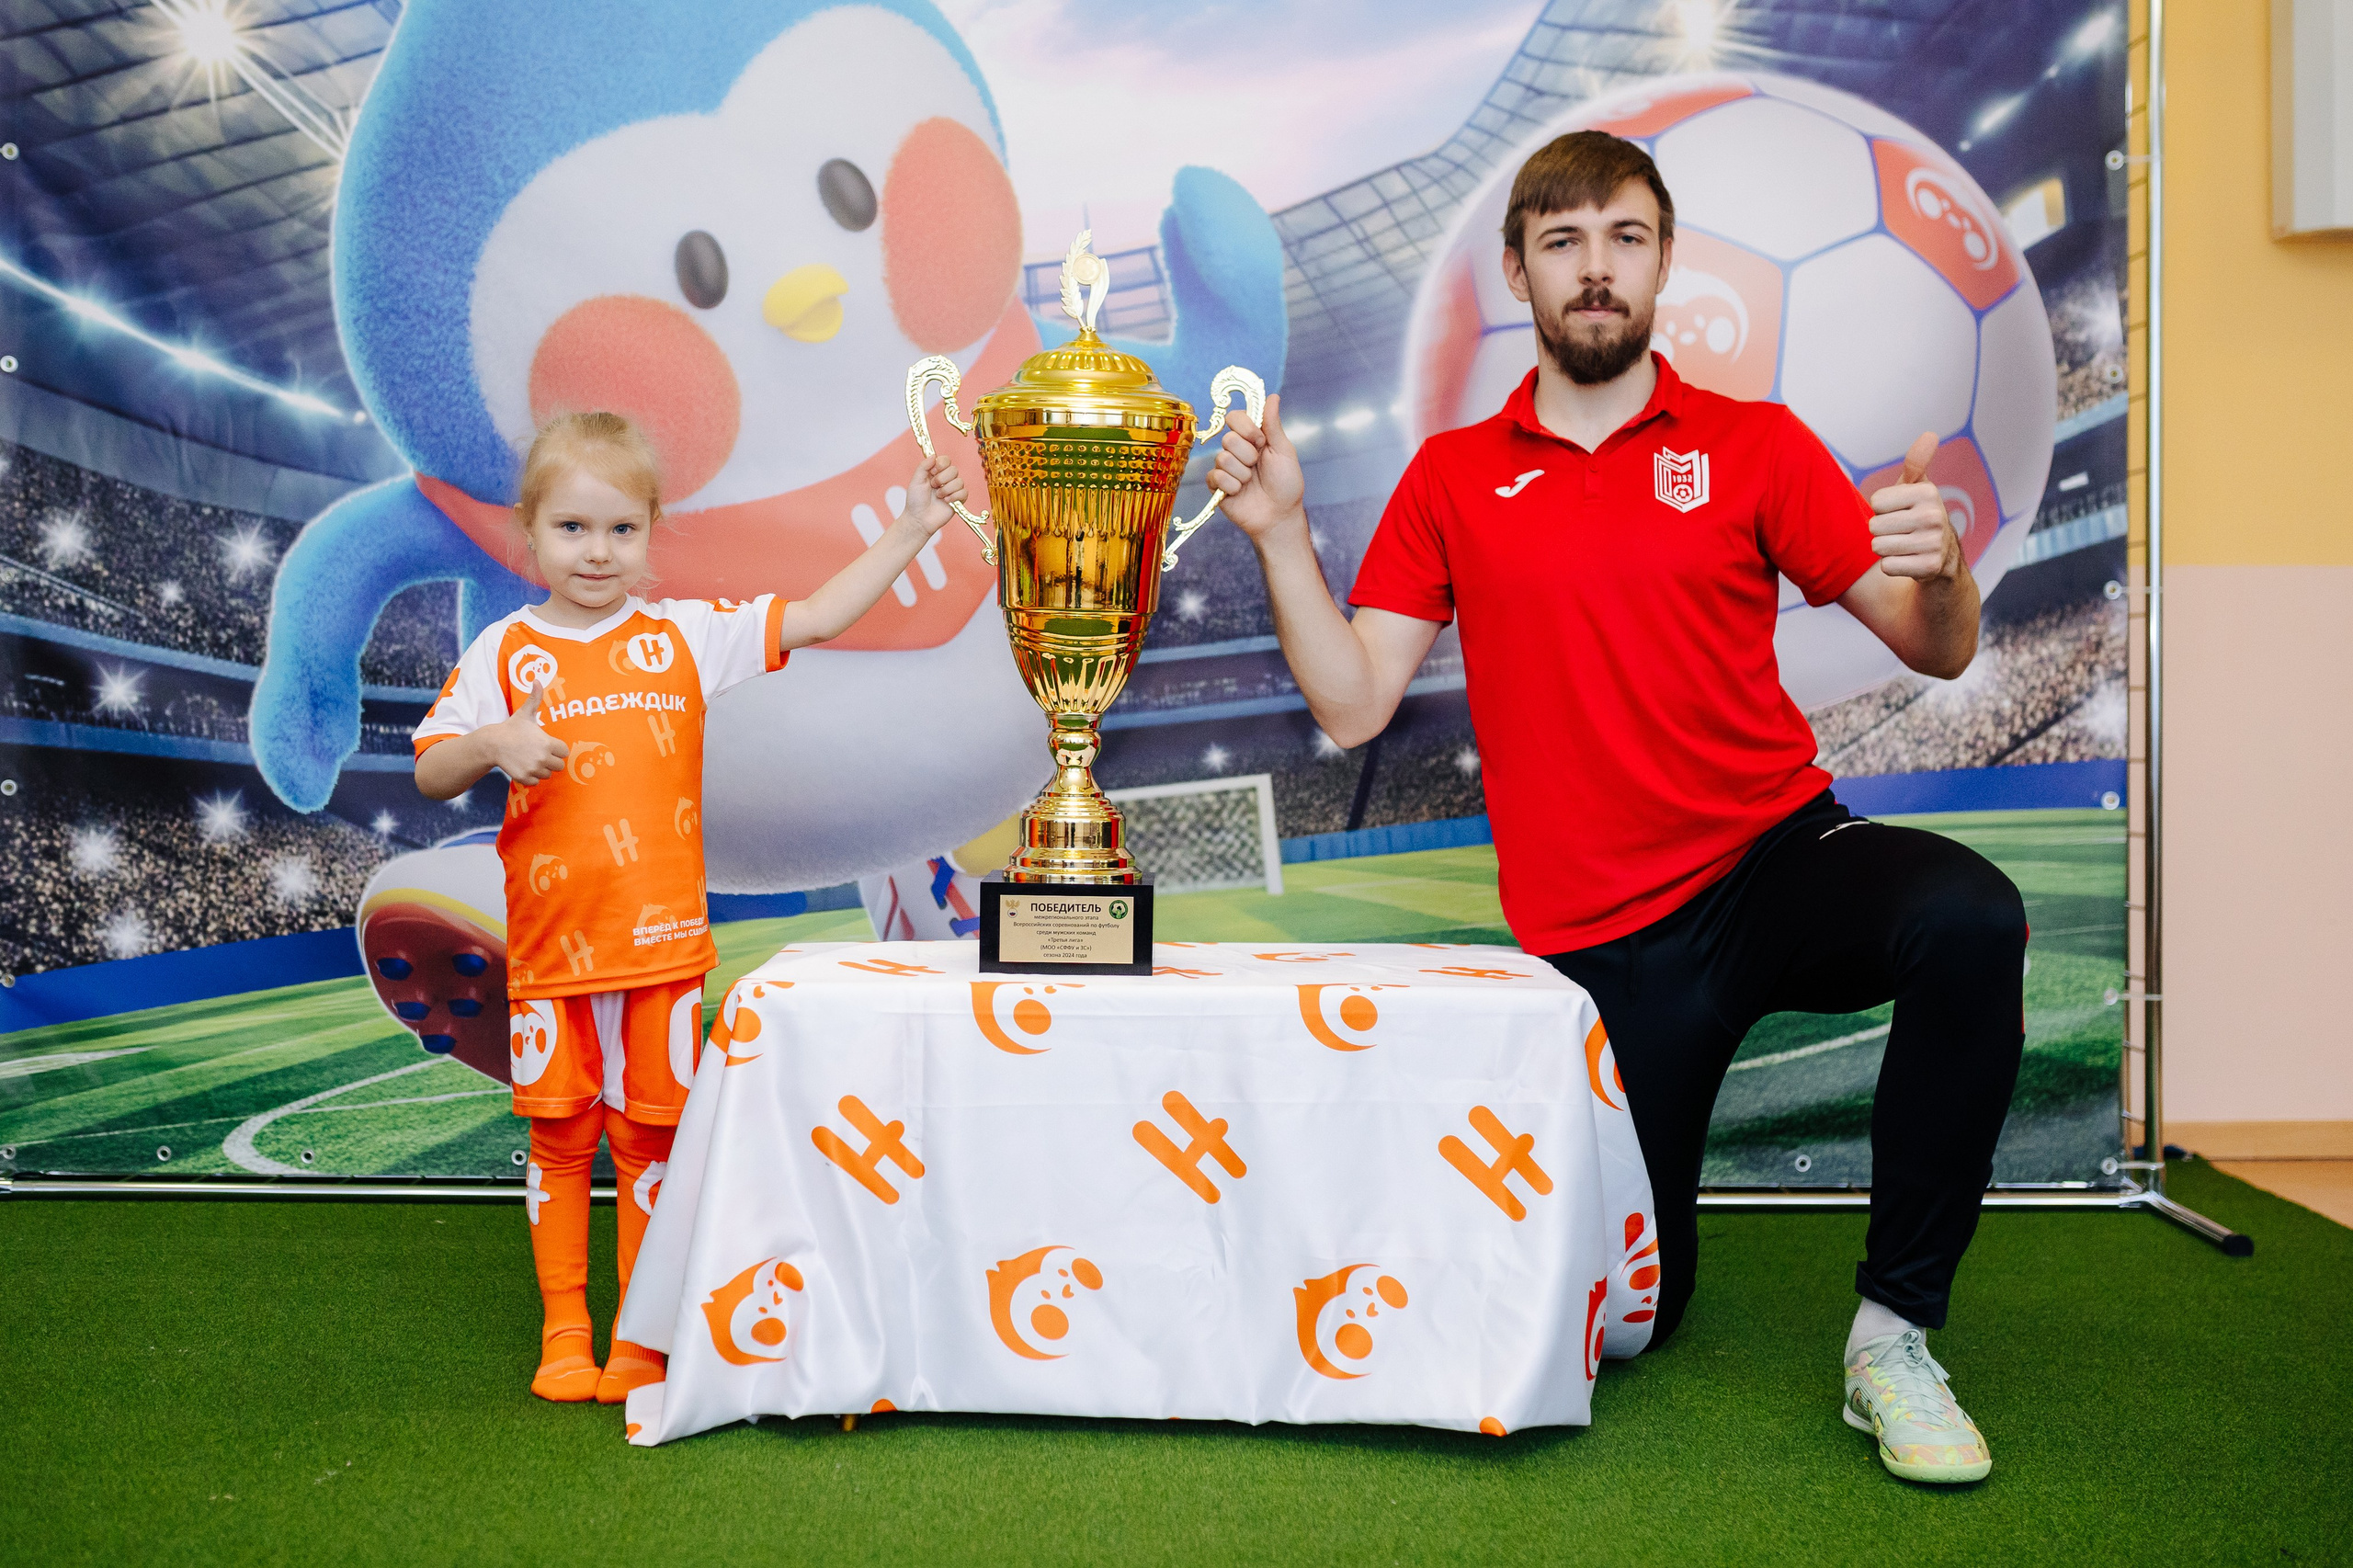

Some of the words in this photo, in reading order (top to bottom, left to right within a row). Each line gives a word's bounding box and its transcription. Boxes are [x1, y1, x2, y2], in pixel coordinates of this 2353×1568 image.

[1673, 474, 1693, 483] 1932
[549, 691, 687, 723] НАДЕЖДИК
[1030, 903, 1102, 914] ПОБЕДИТЕЛЬ
[632, 922, 671, 936] ВПЕРЁД
[634, 933, 673, 946] ВМЕСТЕ
[674, 930, 688, 939] МЫ
